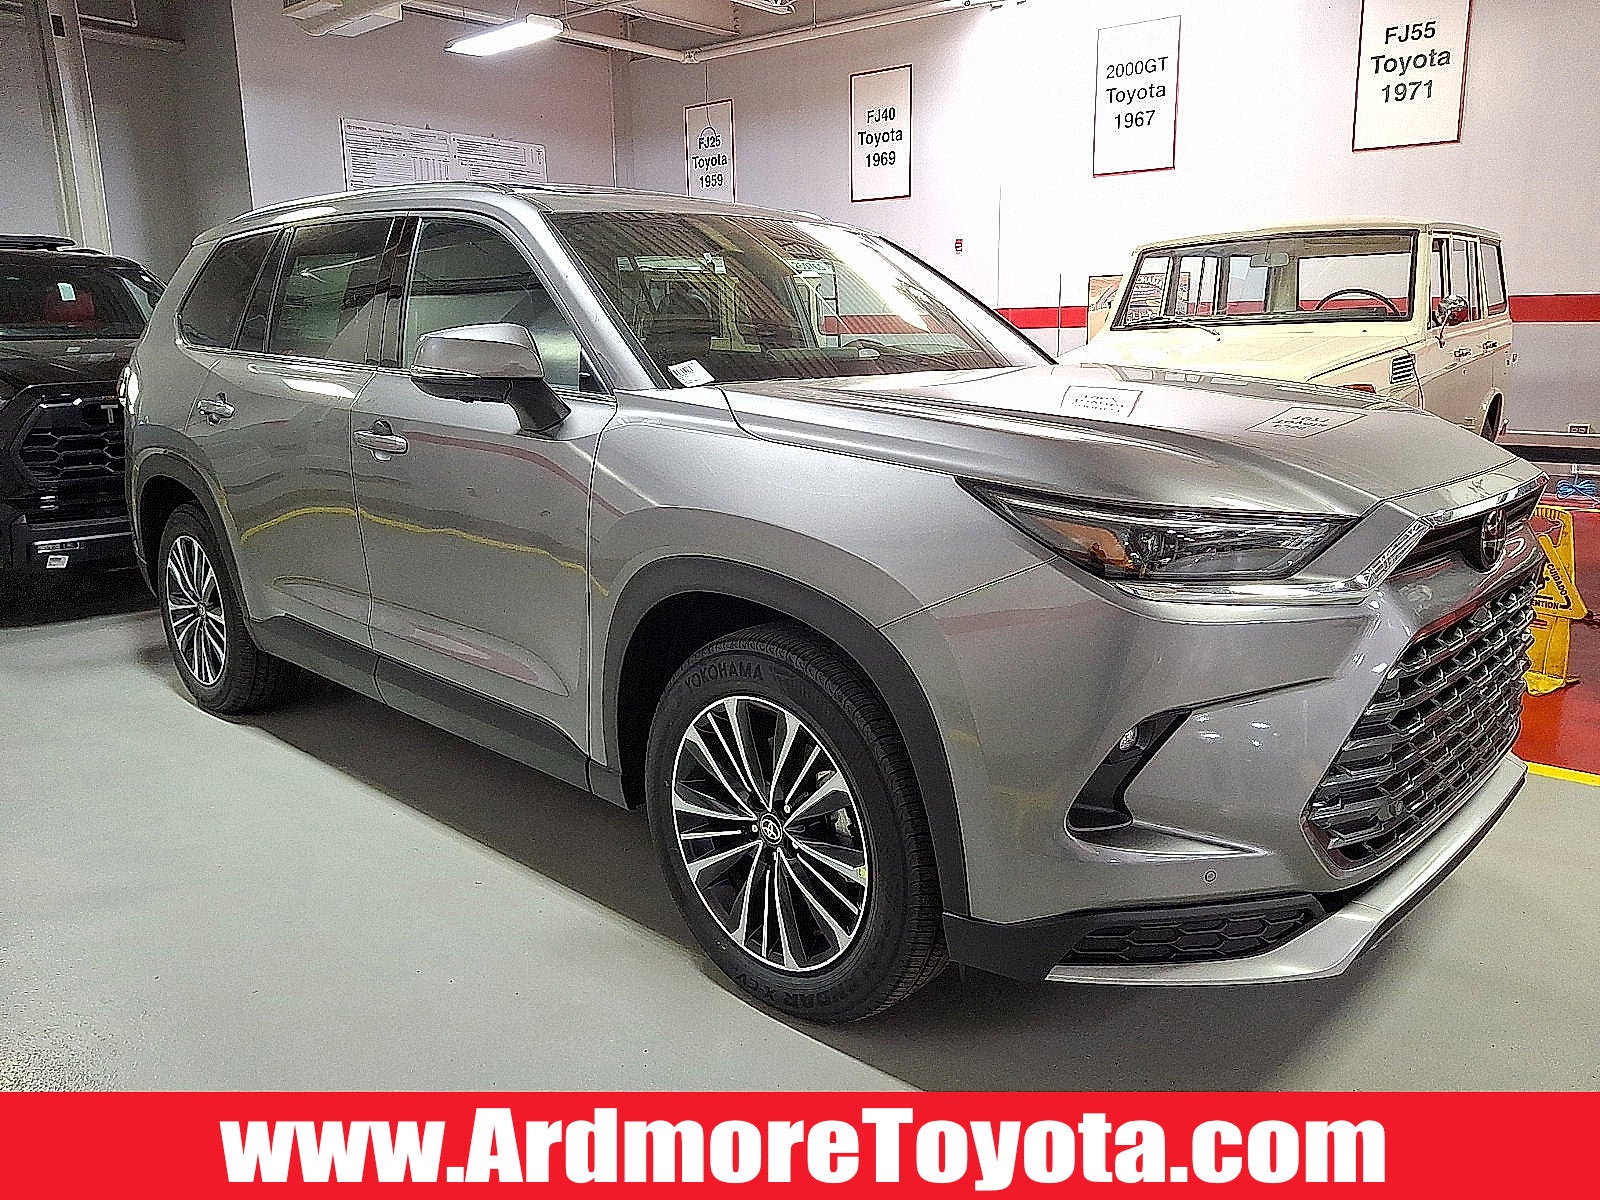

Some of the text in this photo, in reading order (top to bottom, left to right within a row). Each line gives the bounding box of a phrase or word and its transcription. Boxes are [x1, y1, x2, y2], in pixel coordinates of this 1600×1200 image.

[1384, 21, 1437, 45] FJ55
[1106, 57, 1169, 80] 2000GT
[1371, 48, 1452, 76] Toyota
[1106, 84, 1166, 106] Toyota
[1381, 80, 1434, 104] 1971
[866, 107, 896, 124] FJ40
[1114, 110, 1156, 130] 1967
[698, 134, 721, 149] FJ25
[857, 129, 903, 148] Toyota
[691, 153, 728, 170] Toyota
[865, 151, 896, 168] 1969
[699, 174, 723, 188] 1959
[1547, 563, 1567, 596] CUIDADO
[1531, 600, 1559, 610] ENTION
[685, 661, 763, 688] YOKOHAMA
